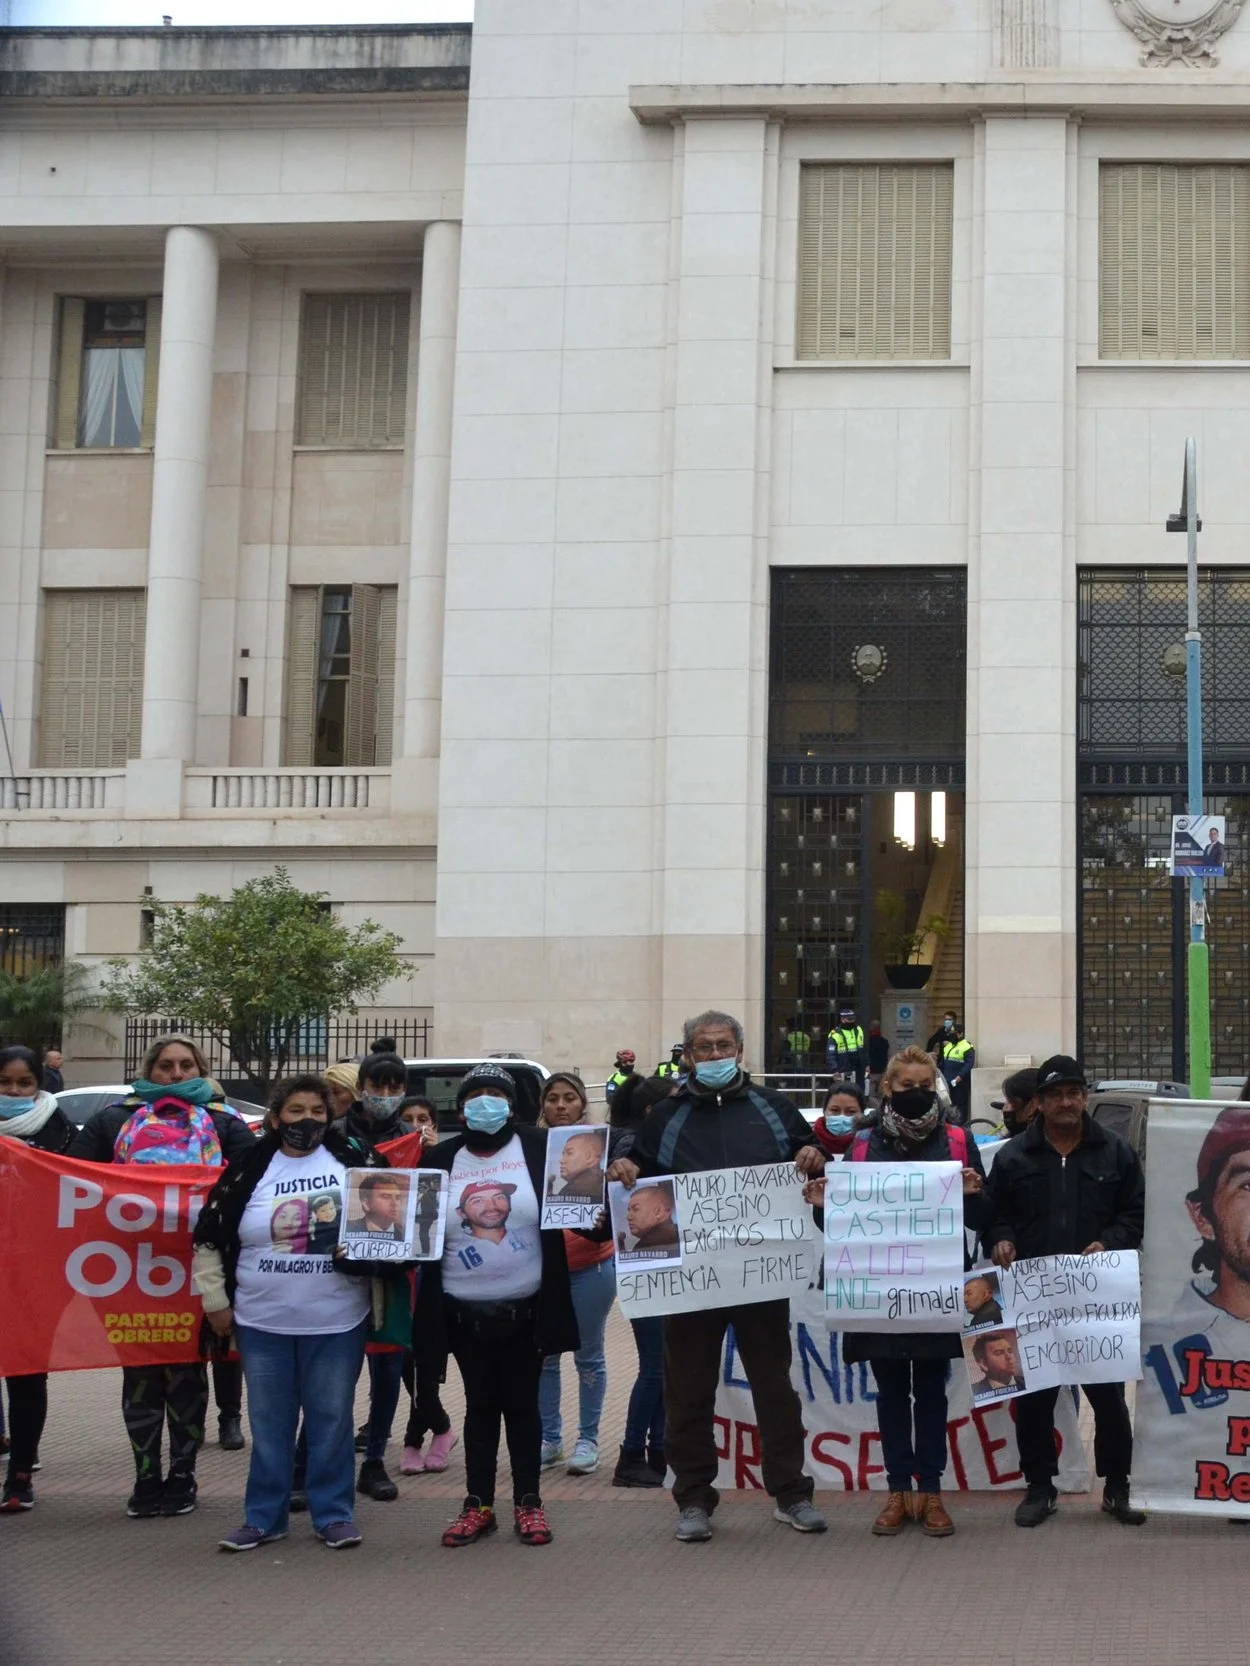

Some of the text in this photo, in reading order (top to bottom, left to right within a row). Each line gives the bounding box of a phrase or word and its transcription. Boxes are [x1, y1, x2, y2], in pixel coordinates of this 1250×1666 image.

[274, 1174, 339, 1197] JUSTICIA
[675, 1163, 806, 1200] MAURO NAVARRO
[939, 1175, 955, 1204] Y
[774, 1218, 805, 1242] TU
[258, 1259, 273, 1272] POR
[274, 1260, 314, 1274] MILAGROS
[315, 1261, 322, 1273] Y
[458, 1245, 483, 1270] 16
[835, 1244, 925, 1275] A LOS
[1054, 1252, 1121, 1271] NAVARRO
[825, 1277, 881, 1311] HNOS
[105, 1312, 195, 1328] PARTIDO
[1015, 1307, 1082, 1339] GERARDO
[107, 1329, 192, 1343] OBRERO
